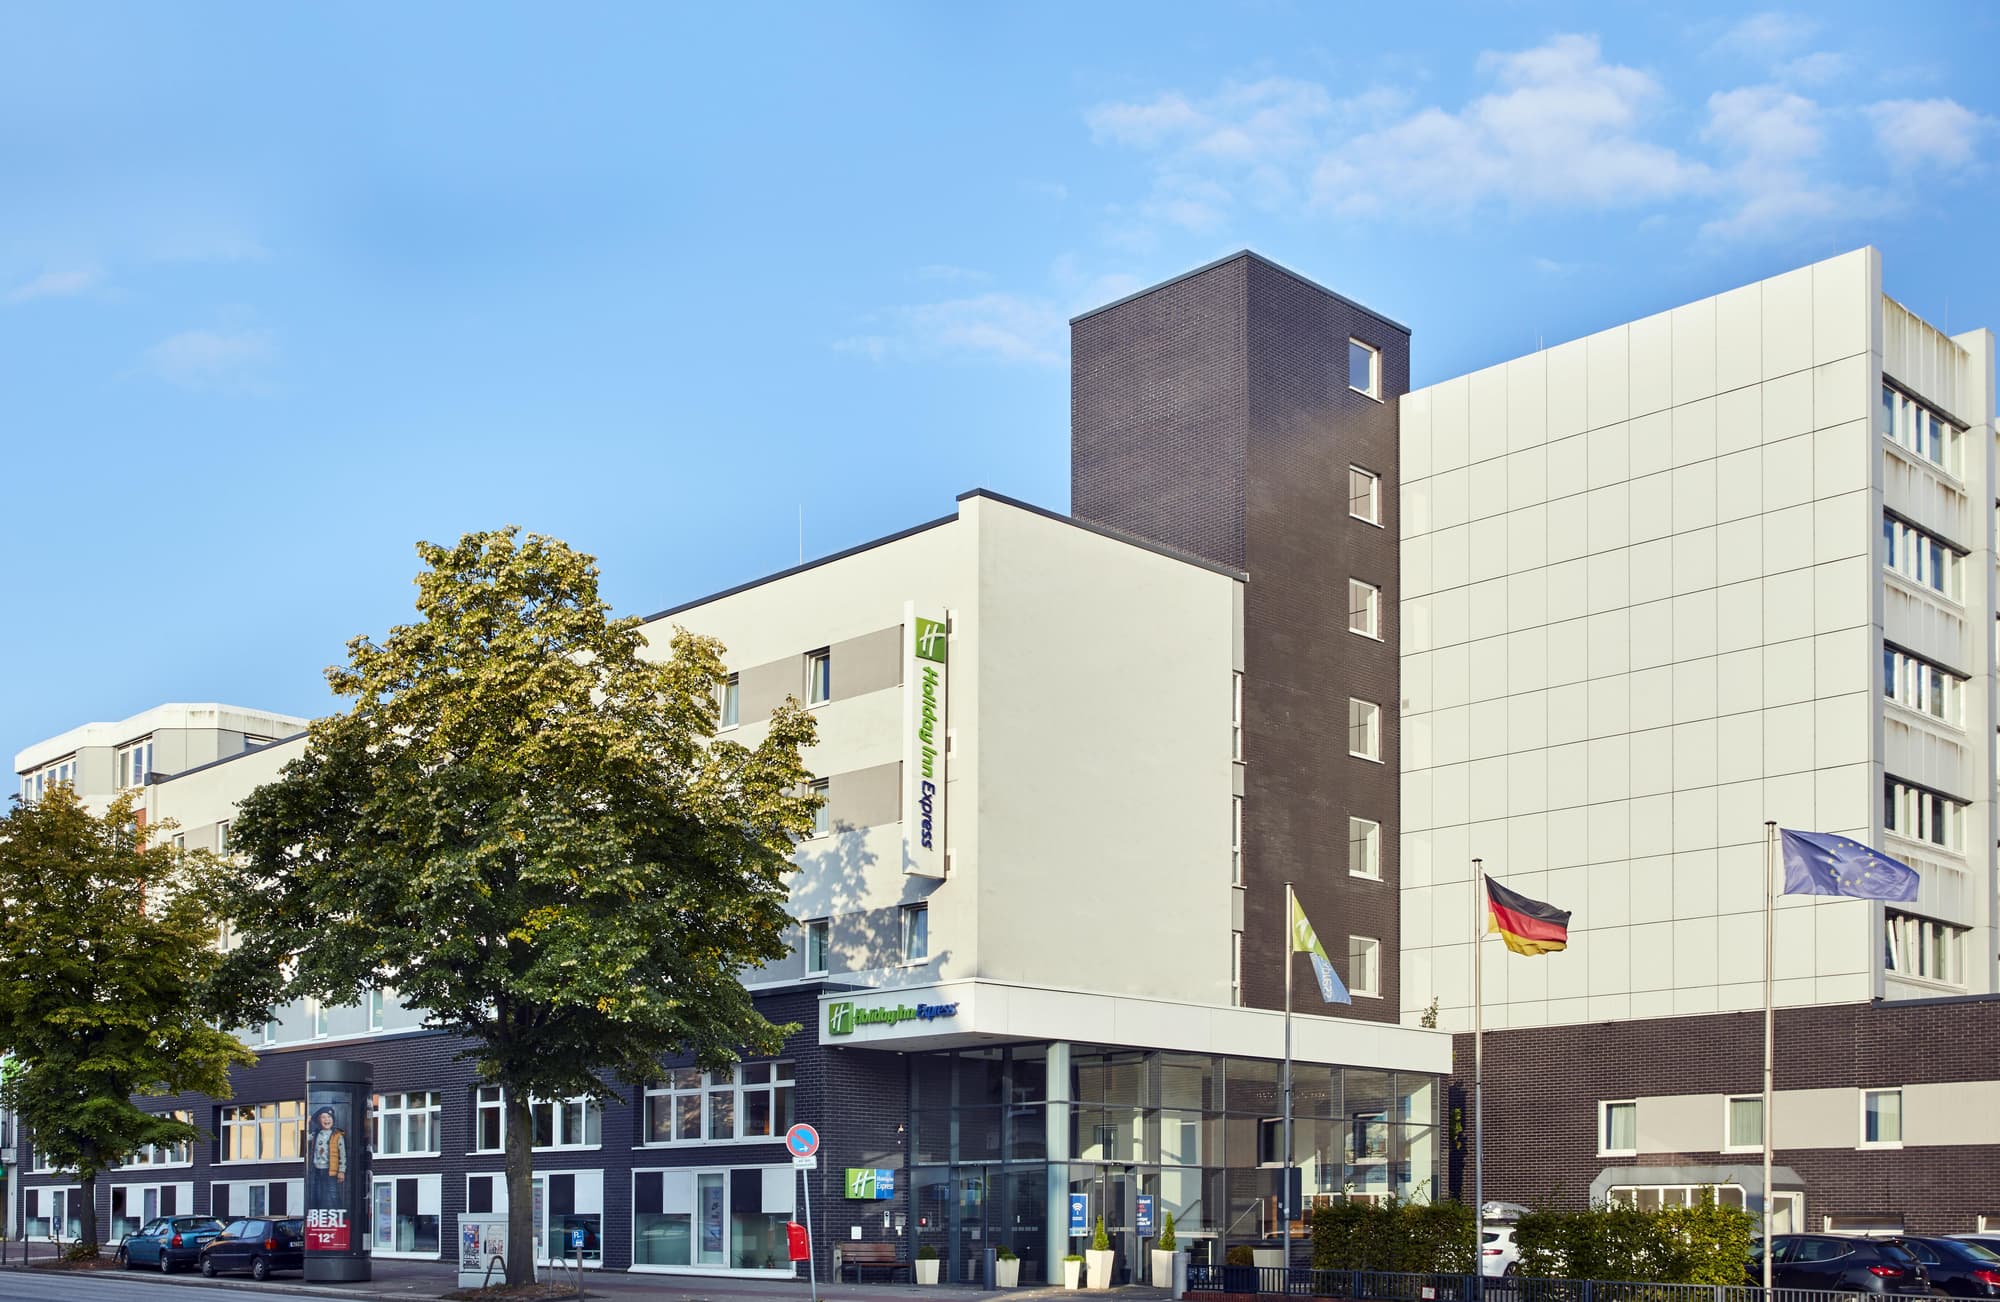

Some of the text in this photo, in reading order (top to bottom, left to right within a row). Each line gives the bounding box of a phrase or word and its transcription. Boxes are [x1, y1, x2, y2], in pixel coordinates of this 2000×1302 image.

[918, 666, 939, 849] Holiday Inn Express
[916, 1003, 957, 1022] Express
[311, 1217, 347, 1228] DEAL
